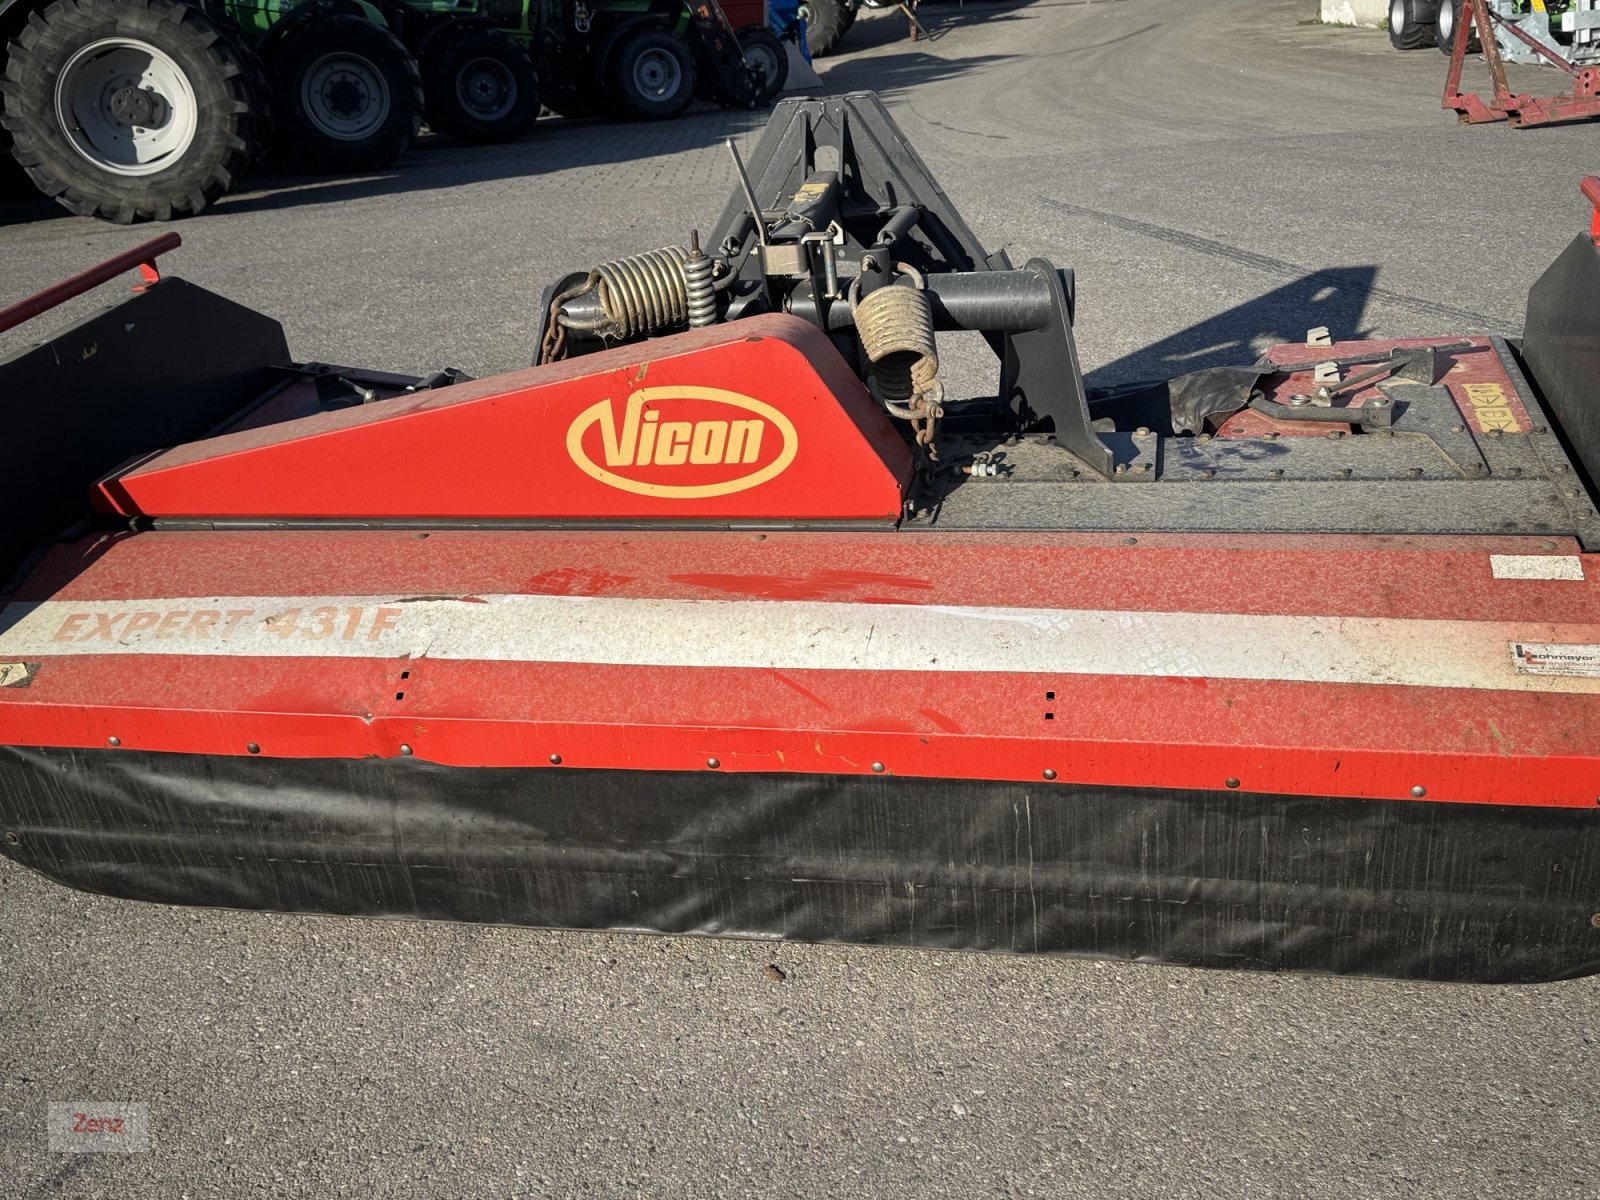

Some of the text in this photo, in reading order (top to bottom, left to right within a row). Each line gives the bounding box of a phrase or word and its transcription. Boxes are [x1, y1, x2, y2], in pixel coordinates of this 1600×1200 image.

[598, 389, 766, 467] Vicon
[52, 606, 403, 642] EXPERT 431F
